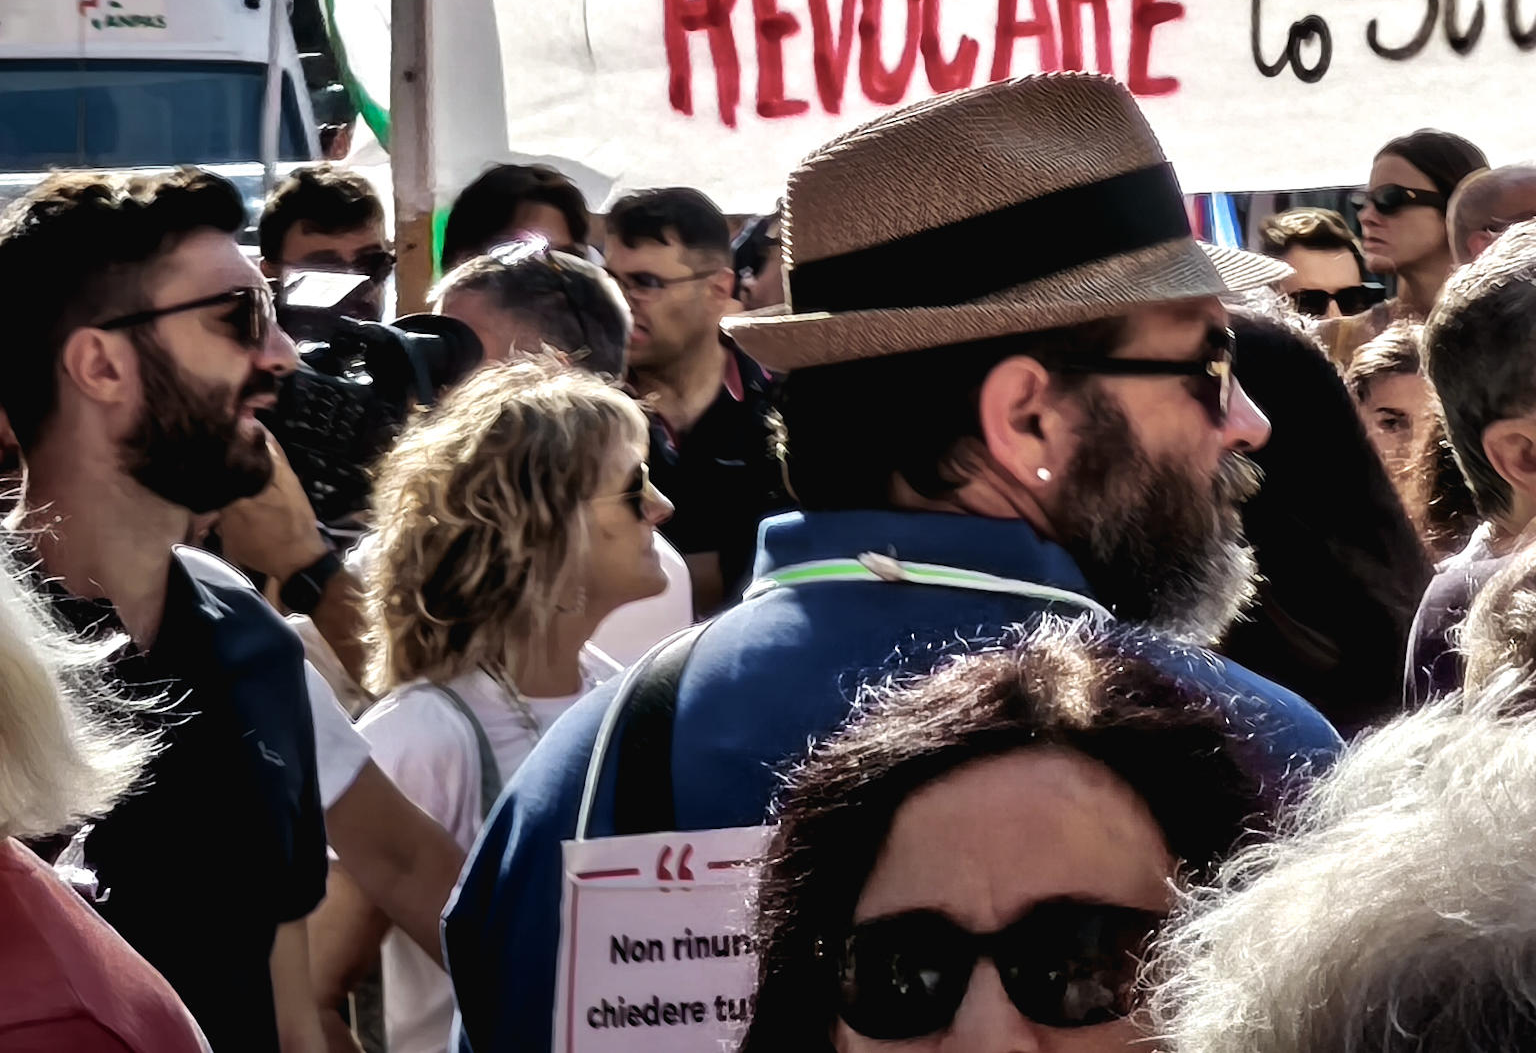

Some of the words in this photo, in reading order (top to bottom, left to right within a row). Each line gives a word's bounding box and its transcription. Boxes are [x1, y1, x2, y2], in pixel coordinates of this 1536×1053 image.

[609, 932, 665, 965] Non
[672, 927, 754, 961] rinun
[586, 996, 706, 1030] chiedere
